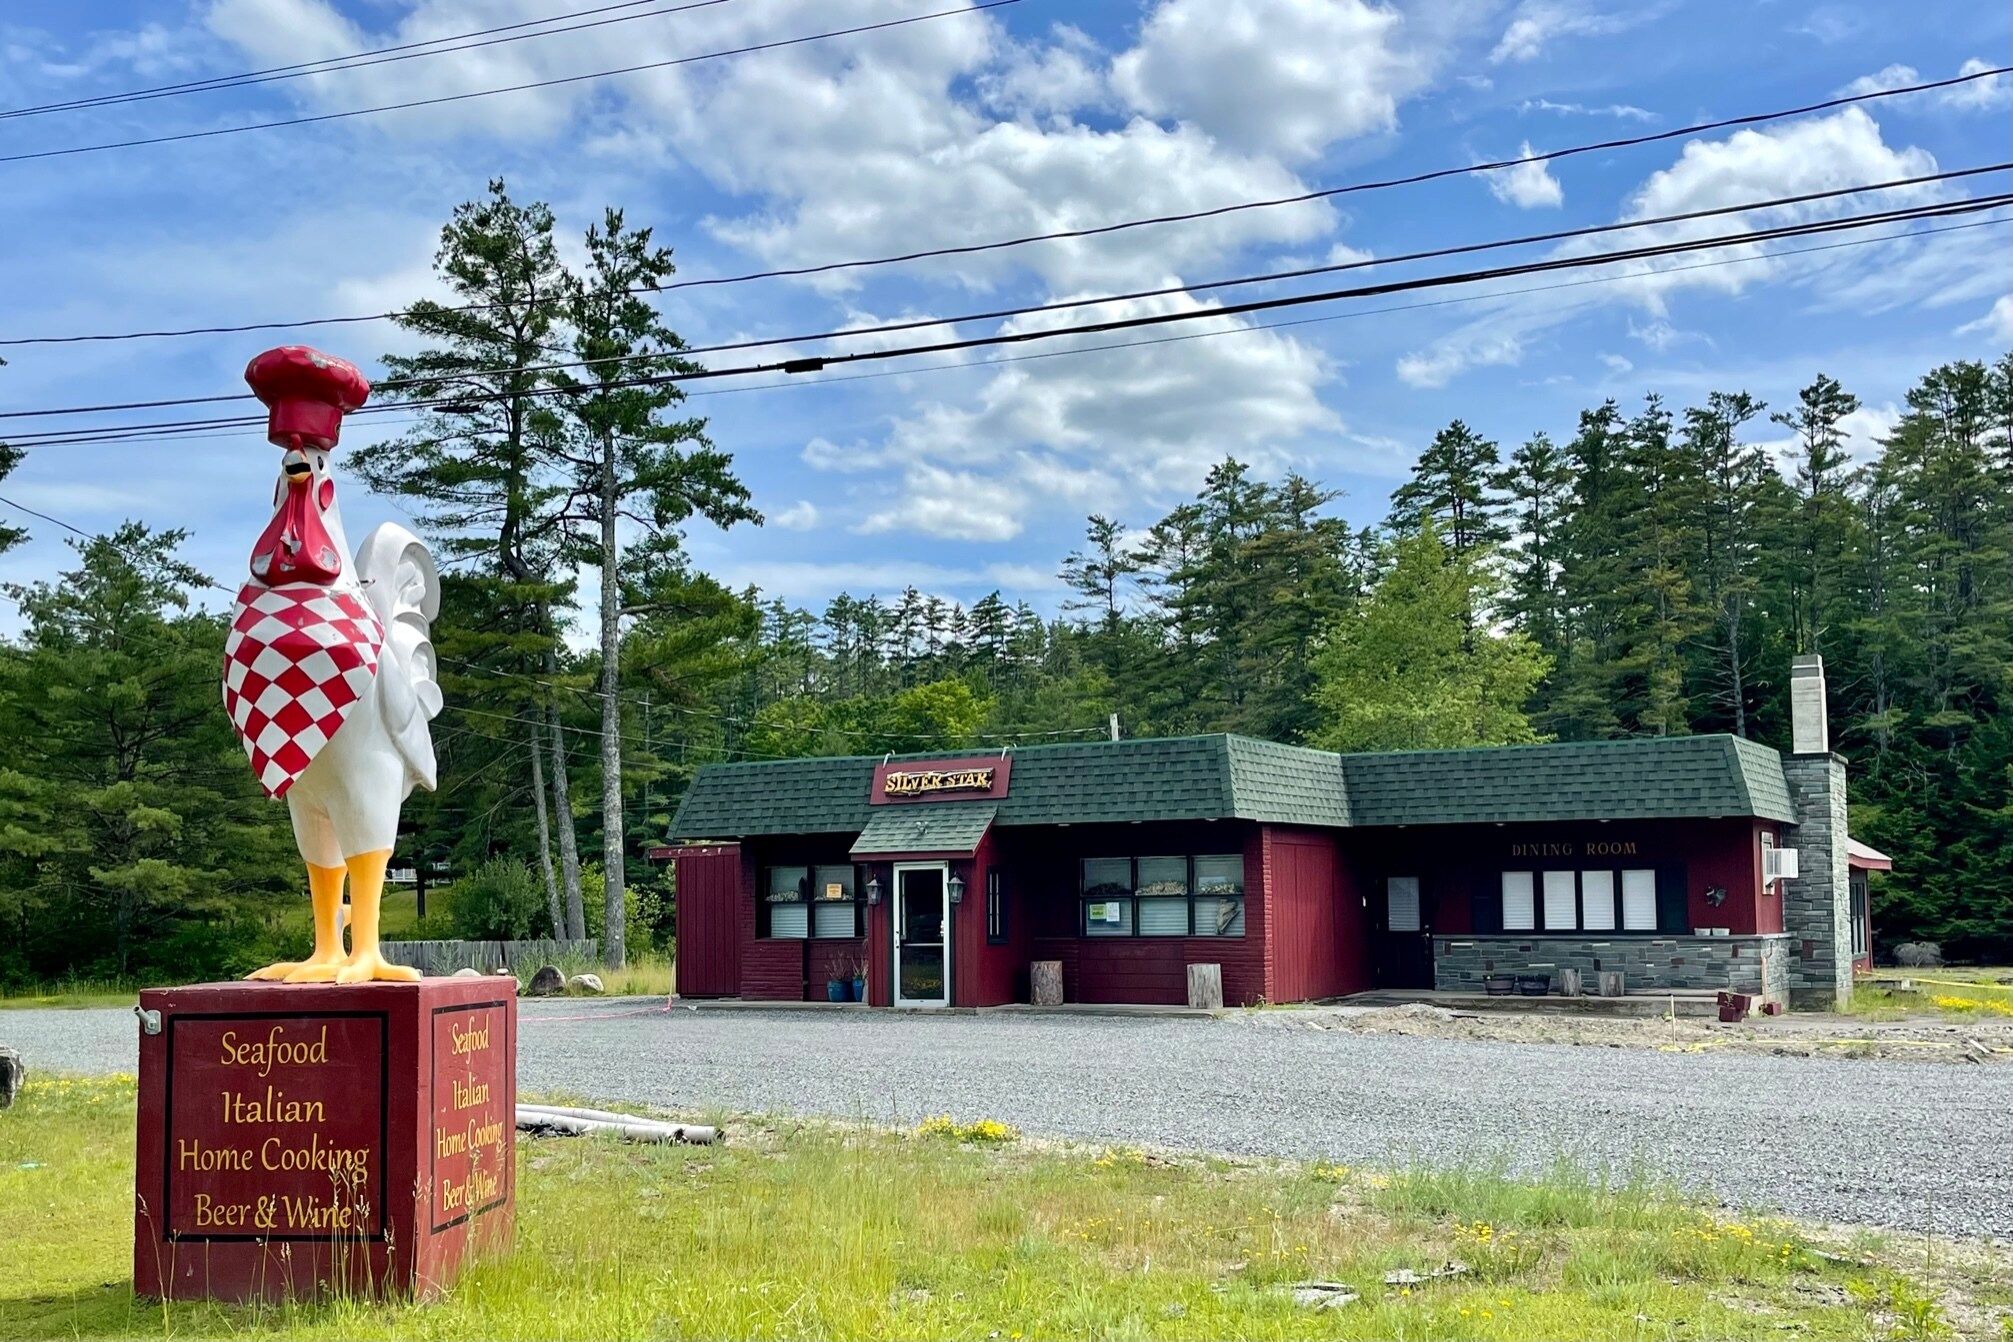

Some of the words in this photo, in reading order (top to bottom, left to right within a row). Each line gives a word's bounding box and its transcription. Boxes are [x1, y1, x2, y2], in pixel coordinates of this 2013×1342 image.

[884, 773, 942, 792] SILVER
[1512, 843, 1572, 856] DINING
[1586, 842, 1636, 855] ROOM
[220, 1025, 328, 1077] Seafood
[452, 1013, 489, 1065] Seafood
[221, 1085, 326, 1123] Italian
[452, 1071, 490, 1110] Italian
[436, 1127, 467, 1159] Home
[467, 1110, 503, 1153] Cooking
[178, 1138, 253, 1171] Home
[261, 1133, 370, 1183] Cooking
[443, 1179, 465, 1211] Beer
[465, 1174, 474, 1206] &
[474, 1168, 498, 1202] Wine
[194, 1193, 251, 1226] Beer
[254, 1195, 278, 1228] &
[281, 1195, 352, 1229] Wine
